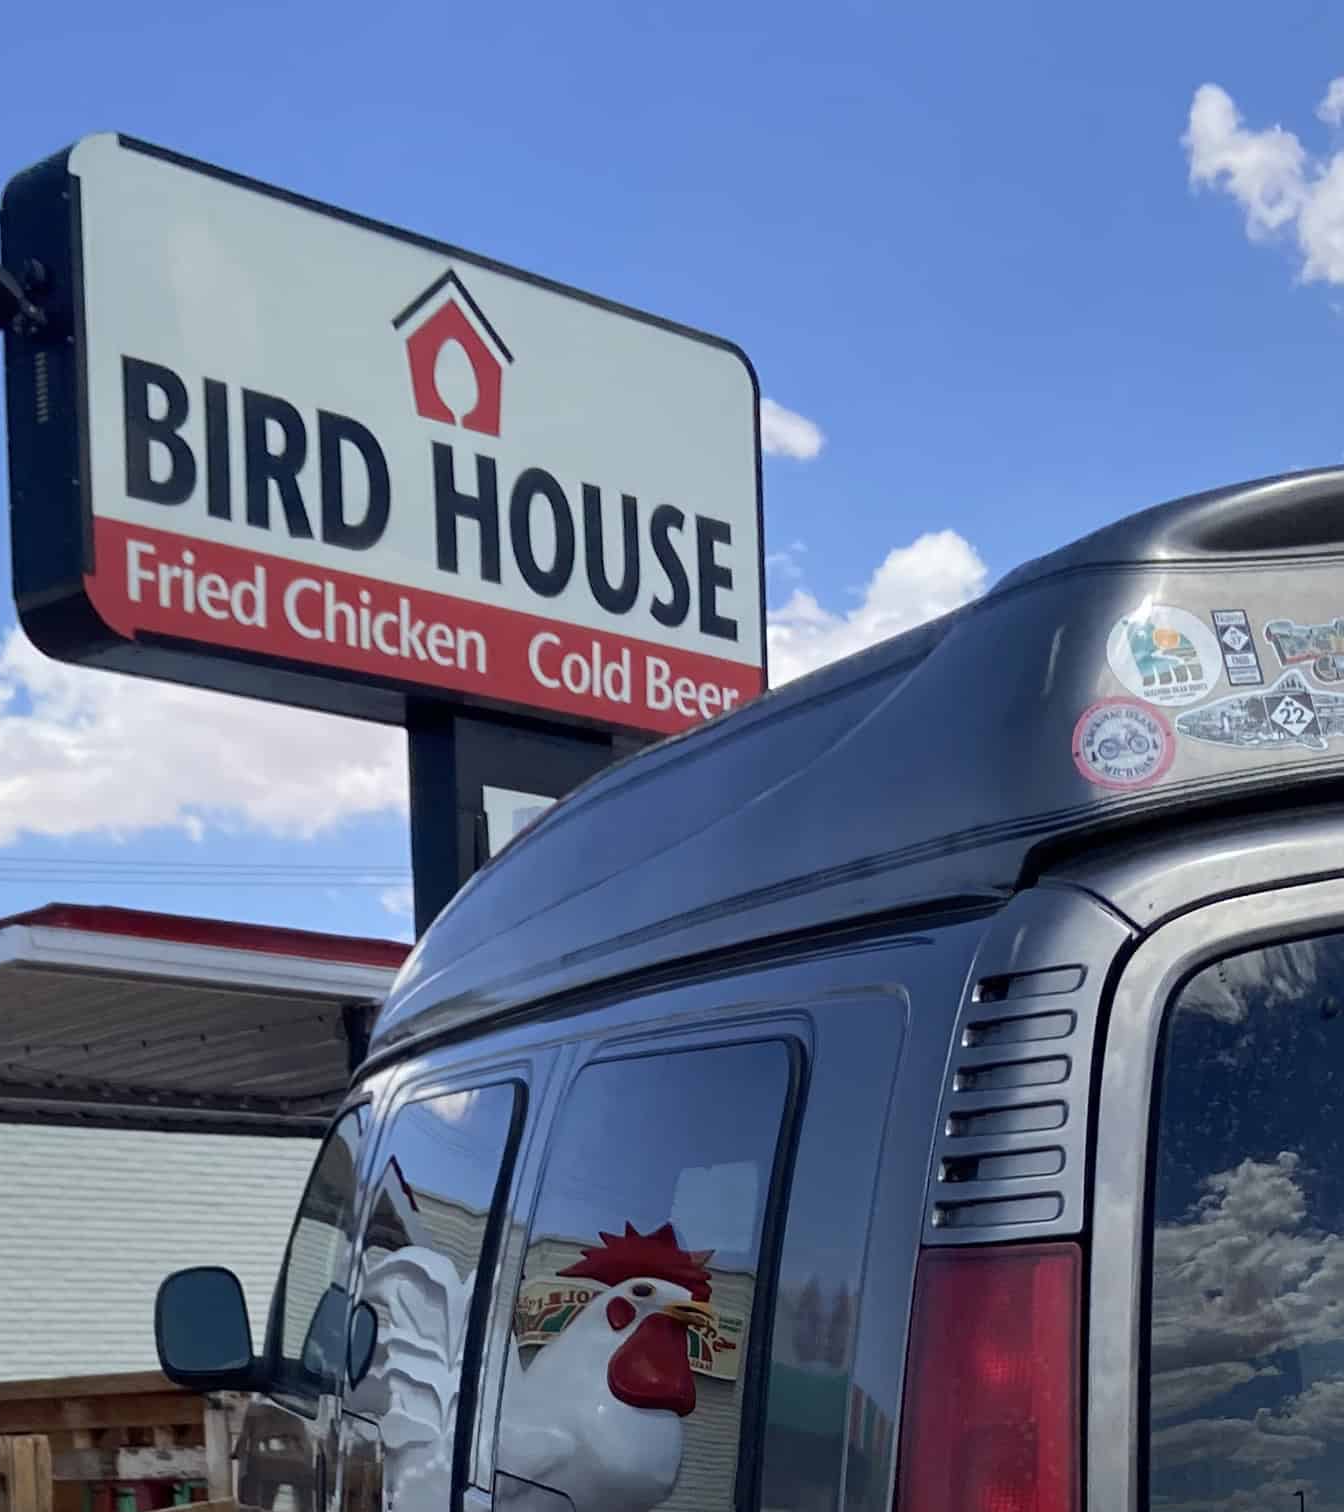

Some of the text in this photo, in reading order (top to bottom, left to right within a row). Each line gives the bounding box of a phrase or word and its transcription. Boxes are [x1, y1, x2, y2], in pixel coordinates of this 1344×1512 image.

[120, 355, 739, 642] BIRD HOUSE
[125, 540, 488, 676] Fried Chicken
[527, 631, 740, 723] Cold Beer
[1279, 706, 1307, 726] 22
